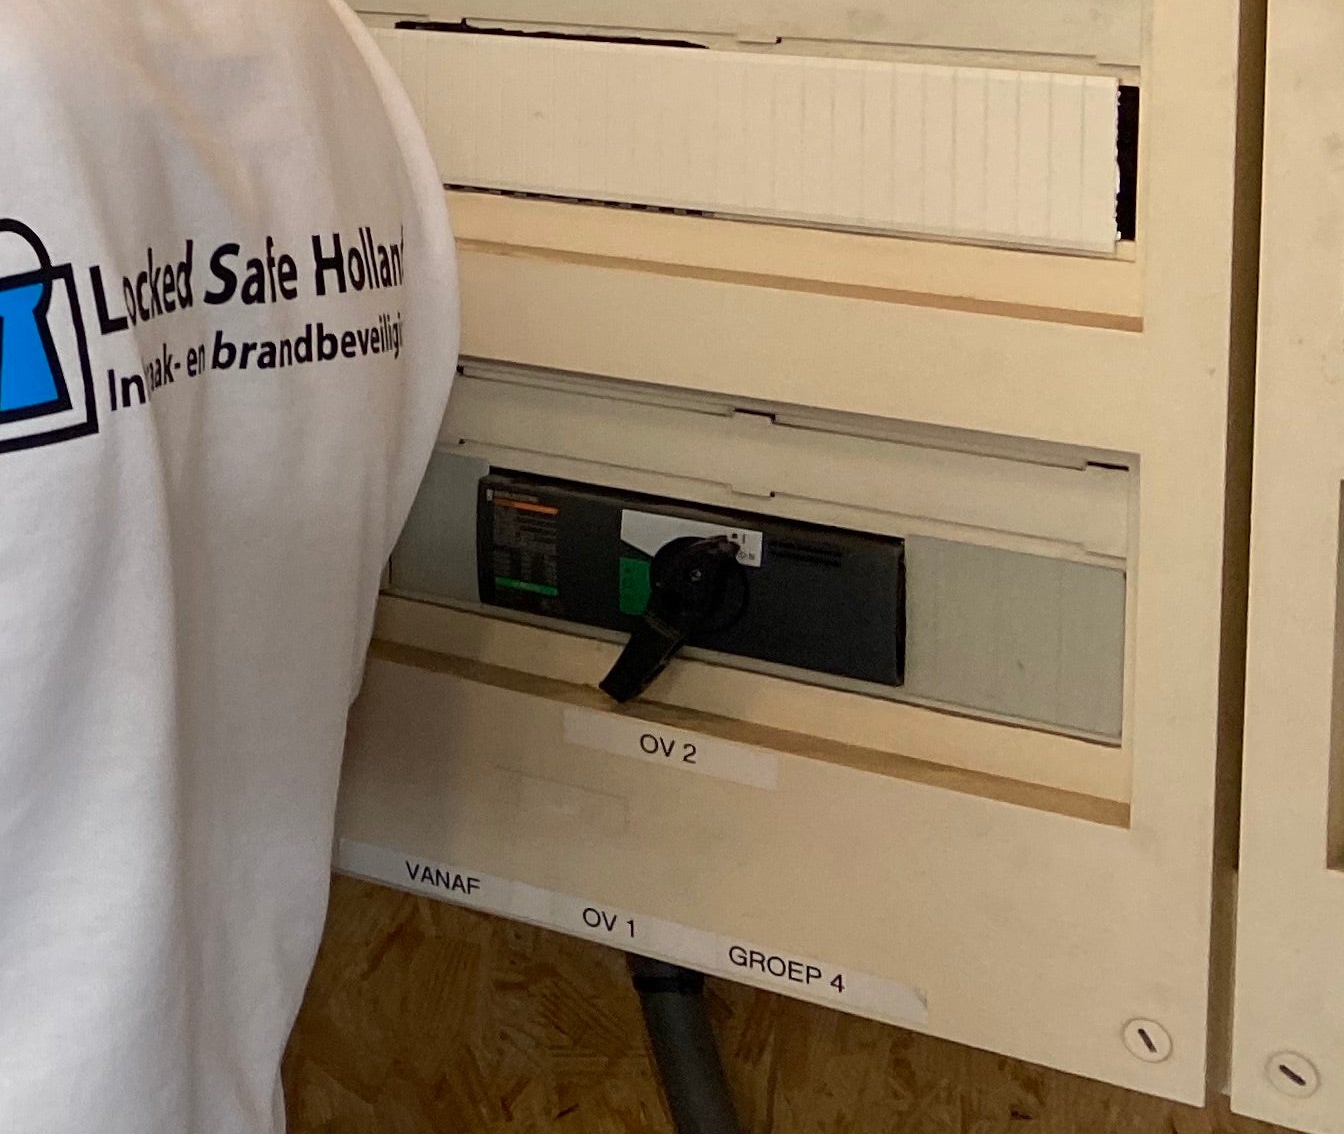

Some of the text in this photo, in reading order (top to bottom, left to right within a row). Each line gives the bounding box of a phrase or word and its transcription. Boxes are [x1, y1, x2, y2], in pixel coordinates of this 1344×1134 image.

[88, 224, 404, 335] Locked Safe Hollan
[186, 343, 206, 378] en
[640, 733, 697, 764] OV 2
[405, 860, 481, 896] VANAF
[582, 907, 636, 938] OV 1
[728, 946, 845, 993] GROEP 4
